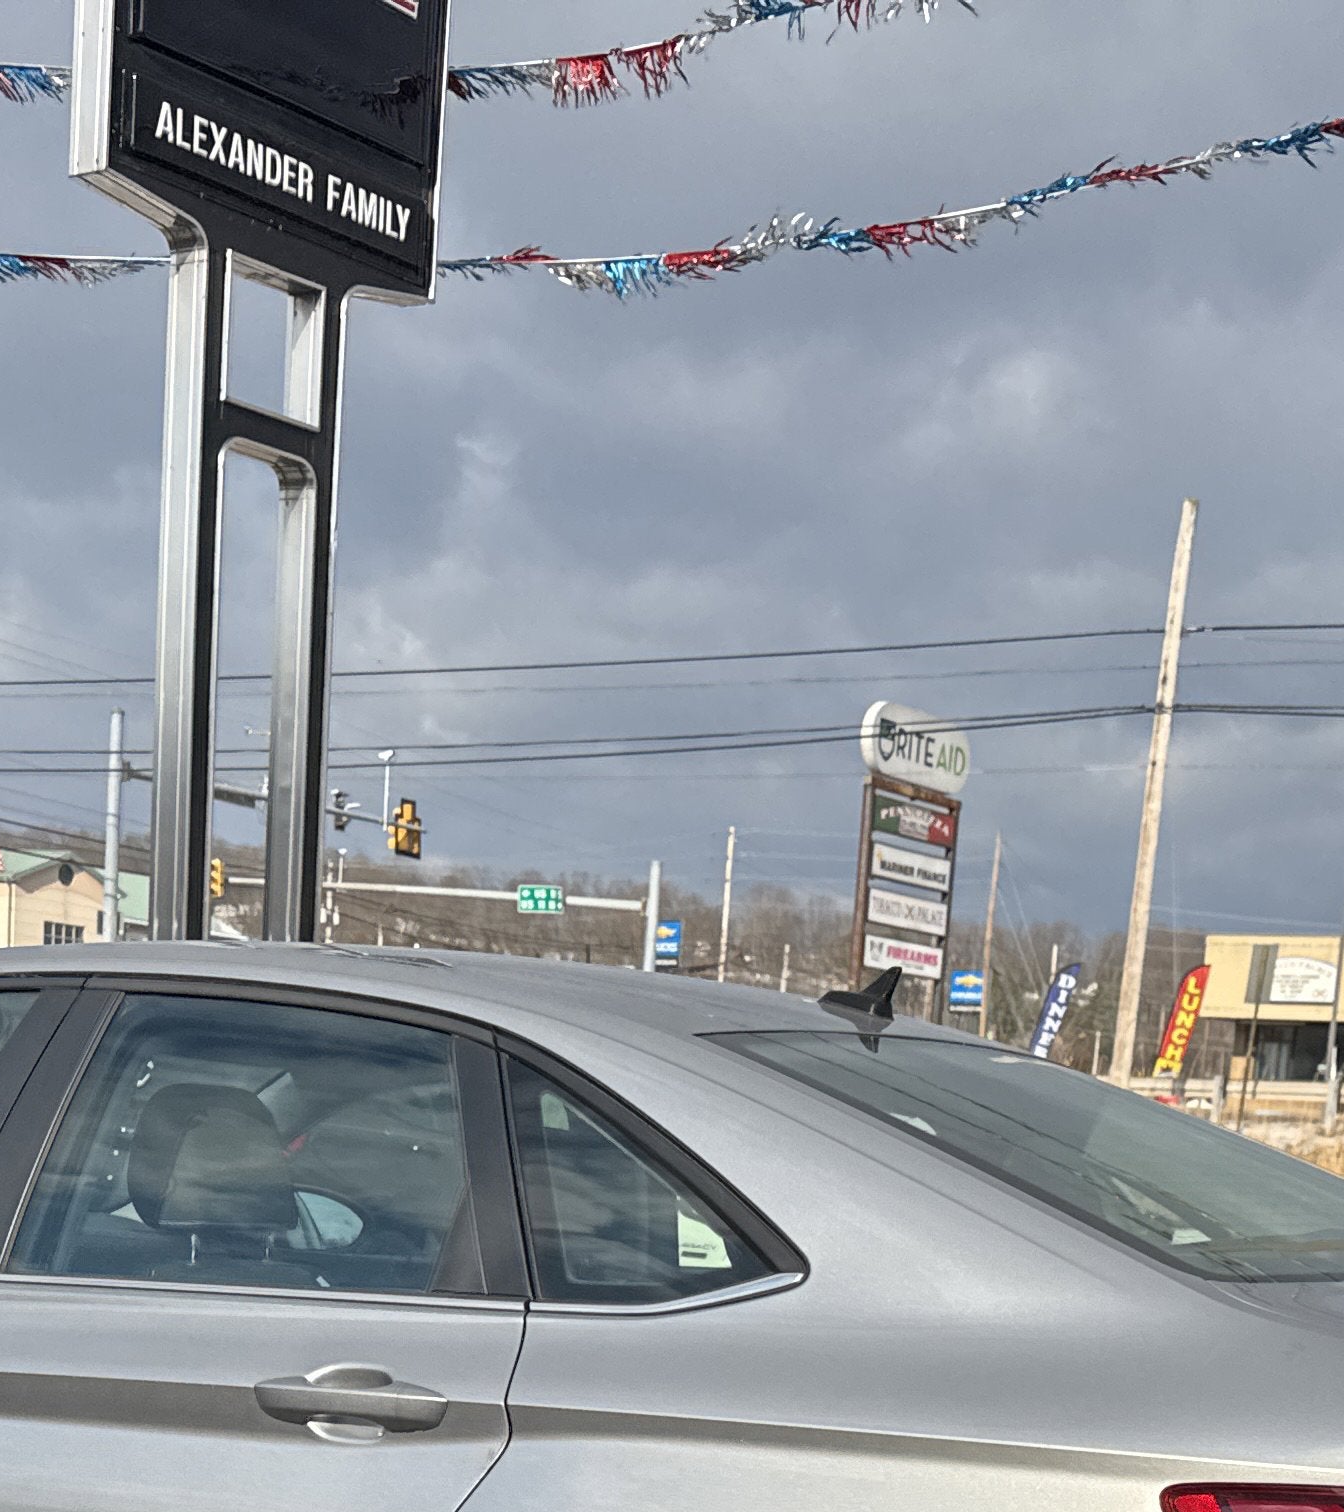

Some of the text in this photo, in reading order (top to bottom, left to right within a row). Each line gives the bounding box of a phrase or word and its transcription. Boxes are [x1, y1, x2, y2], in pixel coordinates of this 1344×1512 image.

[155, 101, 410, 242] ALEXANDER FAMILY
[896, 727, 966, 776] RITE AID
[886, 945, 938, 967] FIREARMS
[1033, 973, 1076, 1059] DINNER
[1165, 976, 1201, 1063] LUNCH
